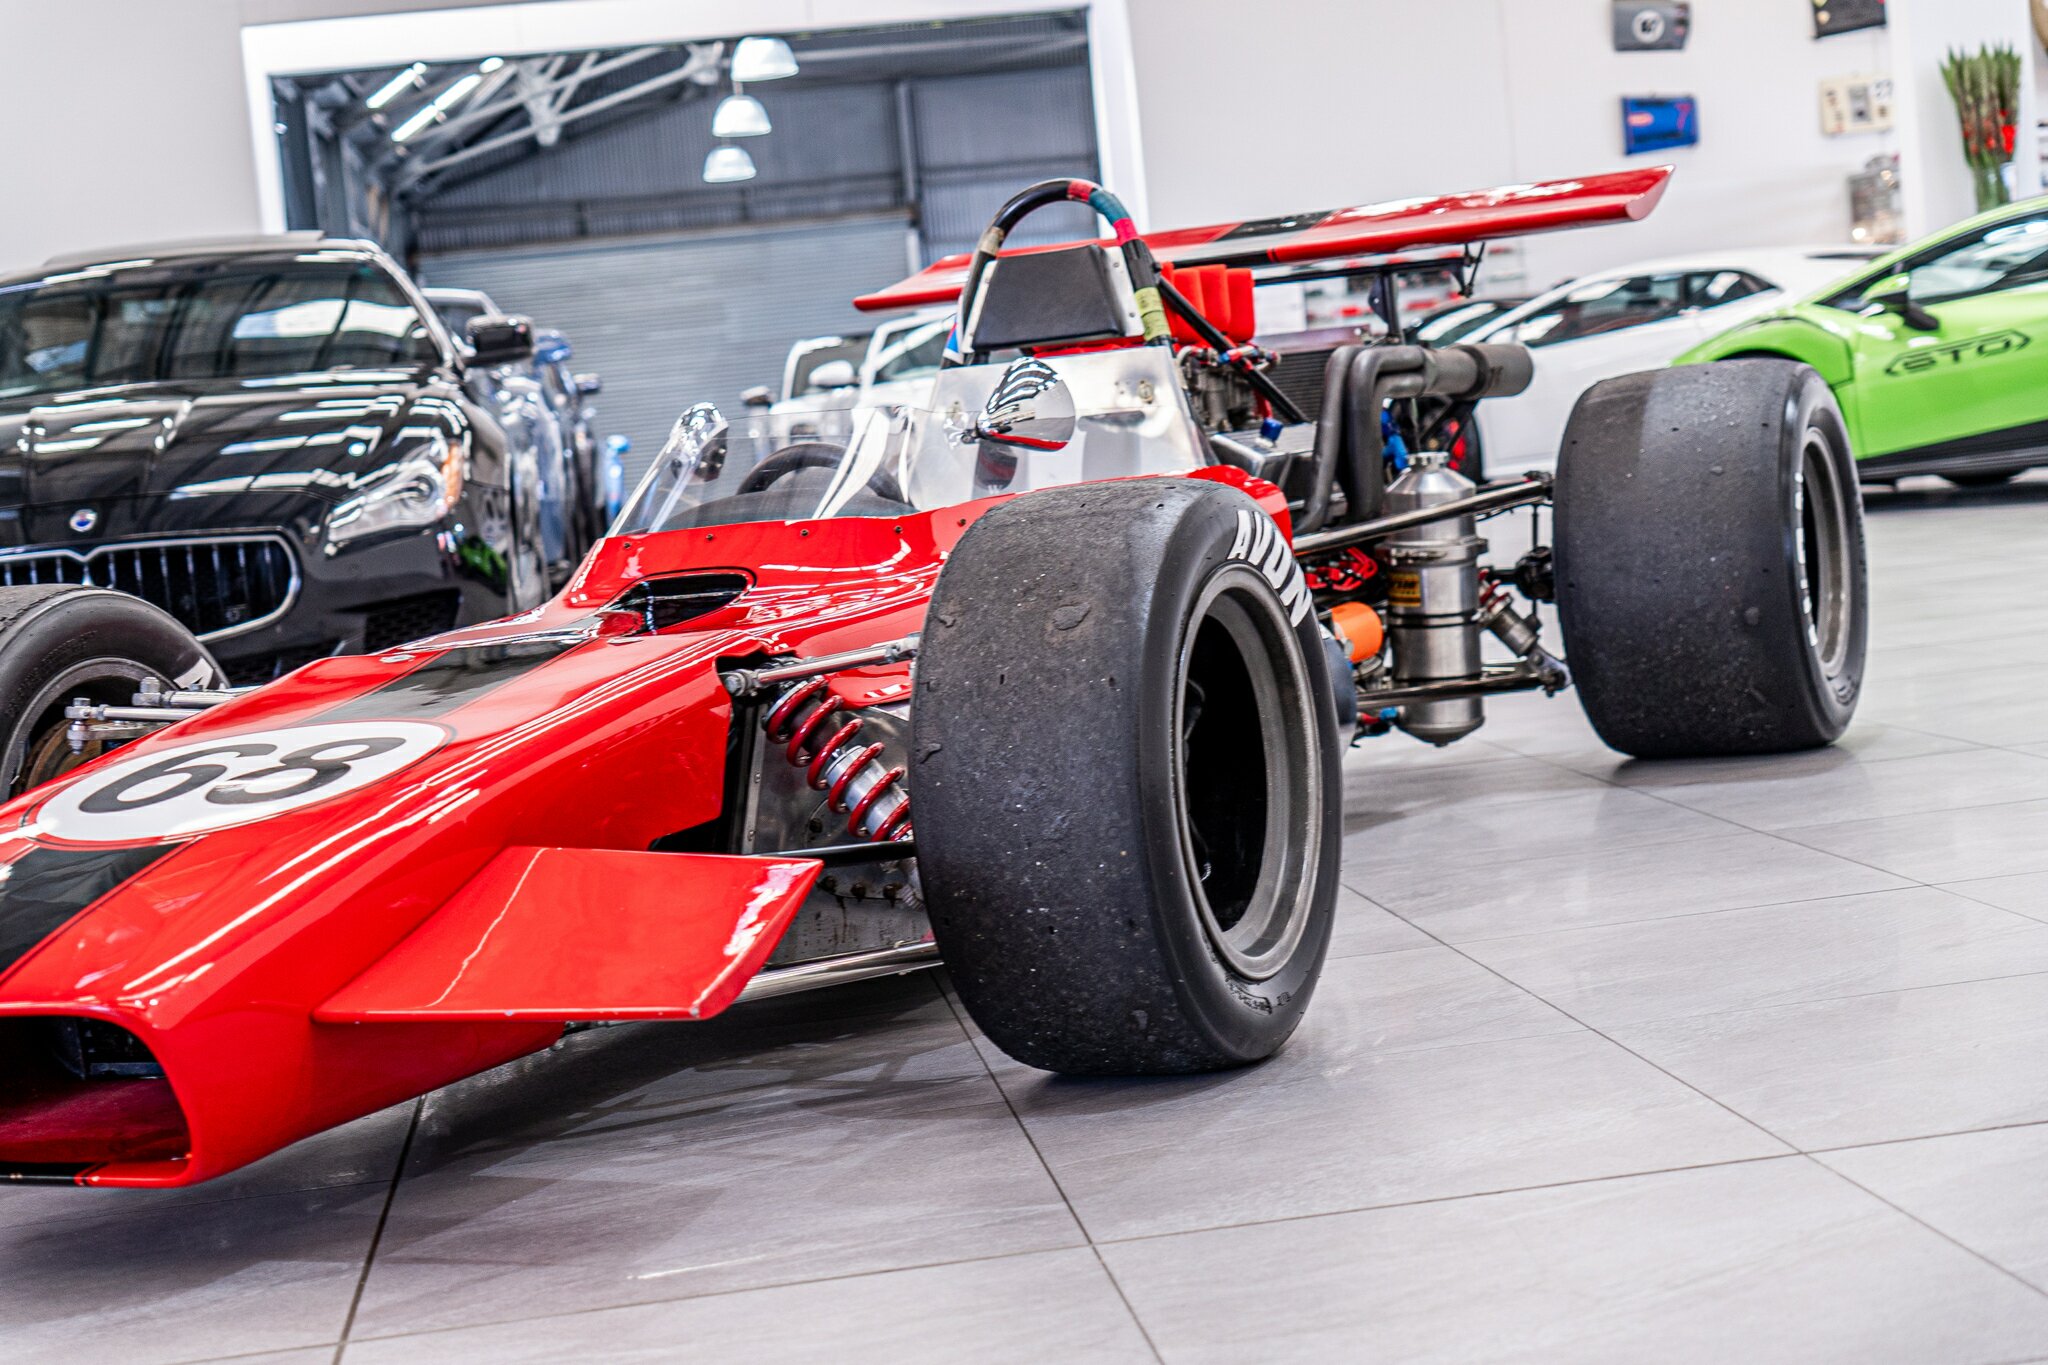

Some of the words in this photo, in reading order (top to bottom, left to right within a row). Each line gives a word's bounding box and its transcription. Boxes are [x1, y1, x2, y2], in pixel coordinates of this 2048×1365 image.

[1903, 335, 2012, 373] STO
[1227, 510, 1313, 627] AVON
[79, 737, 406, 814] 68
